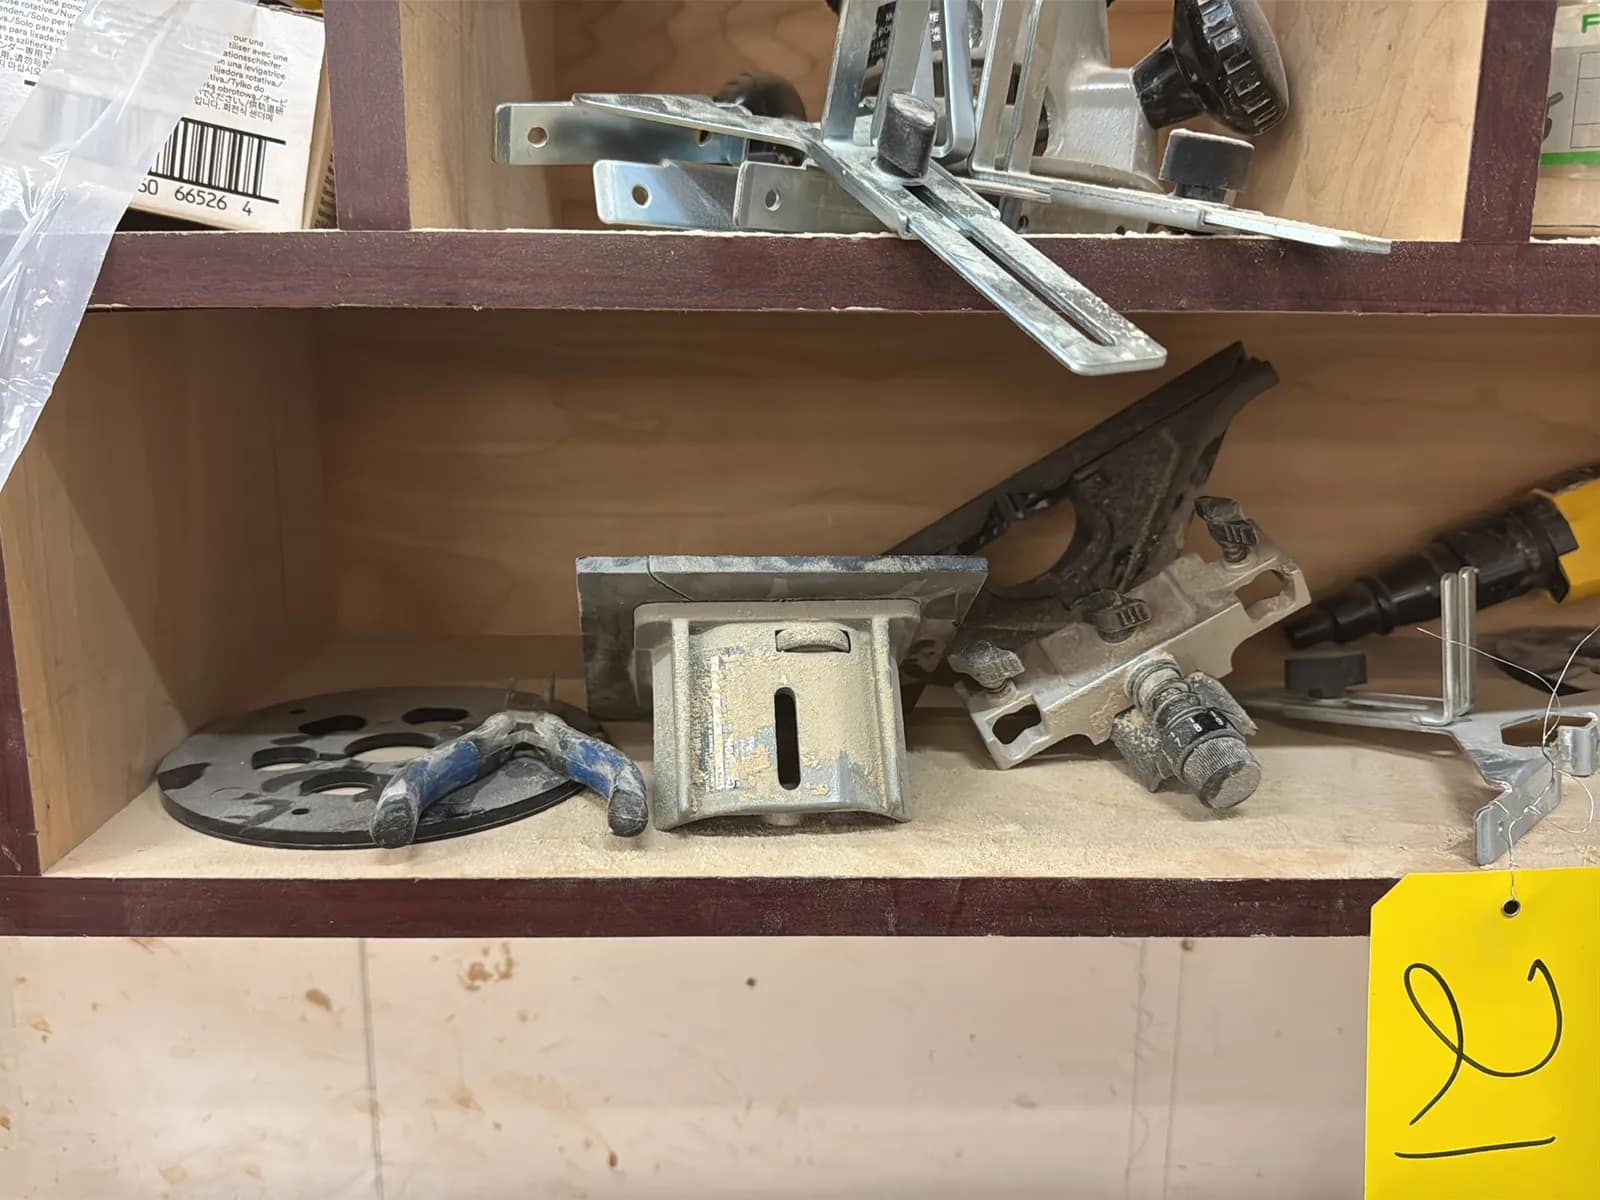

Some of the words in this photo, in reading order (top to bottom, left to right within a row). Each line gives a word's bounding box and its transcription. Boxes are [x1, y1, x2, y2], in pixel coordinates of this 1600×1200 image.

[249, 39, 264, 47] une
[252, 49, 272, 58] avec
[273, 54, 288, 62] une
[227, 60, 242, 69] una
[244, 63, 286, 80] levigatrice
[208, 74, 252, 90] tiva./Tylko
[253, 85, 265, 93] do
[174, 186, 228, 211] 66526
[242, 200, 253, 216] 4
